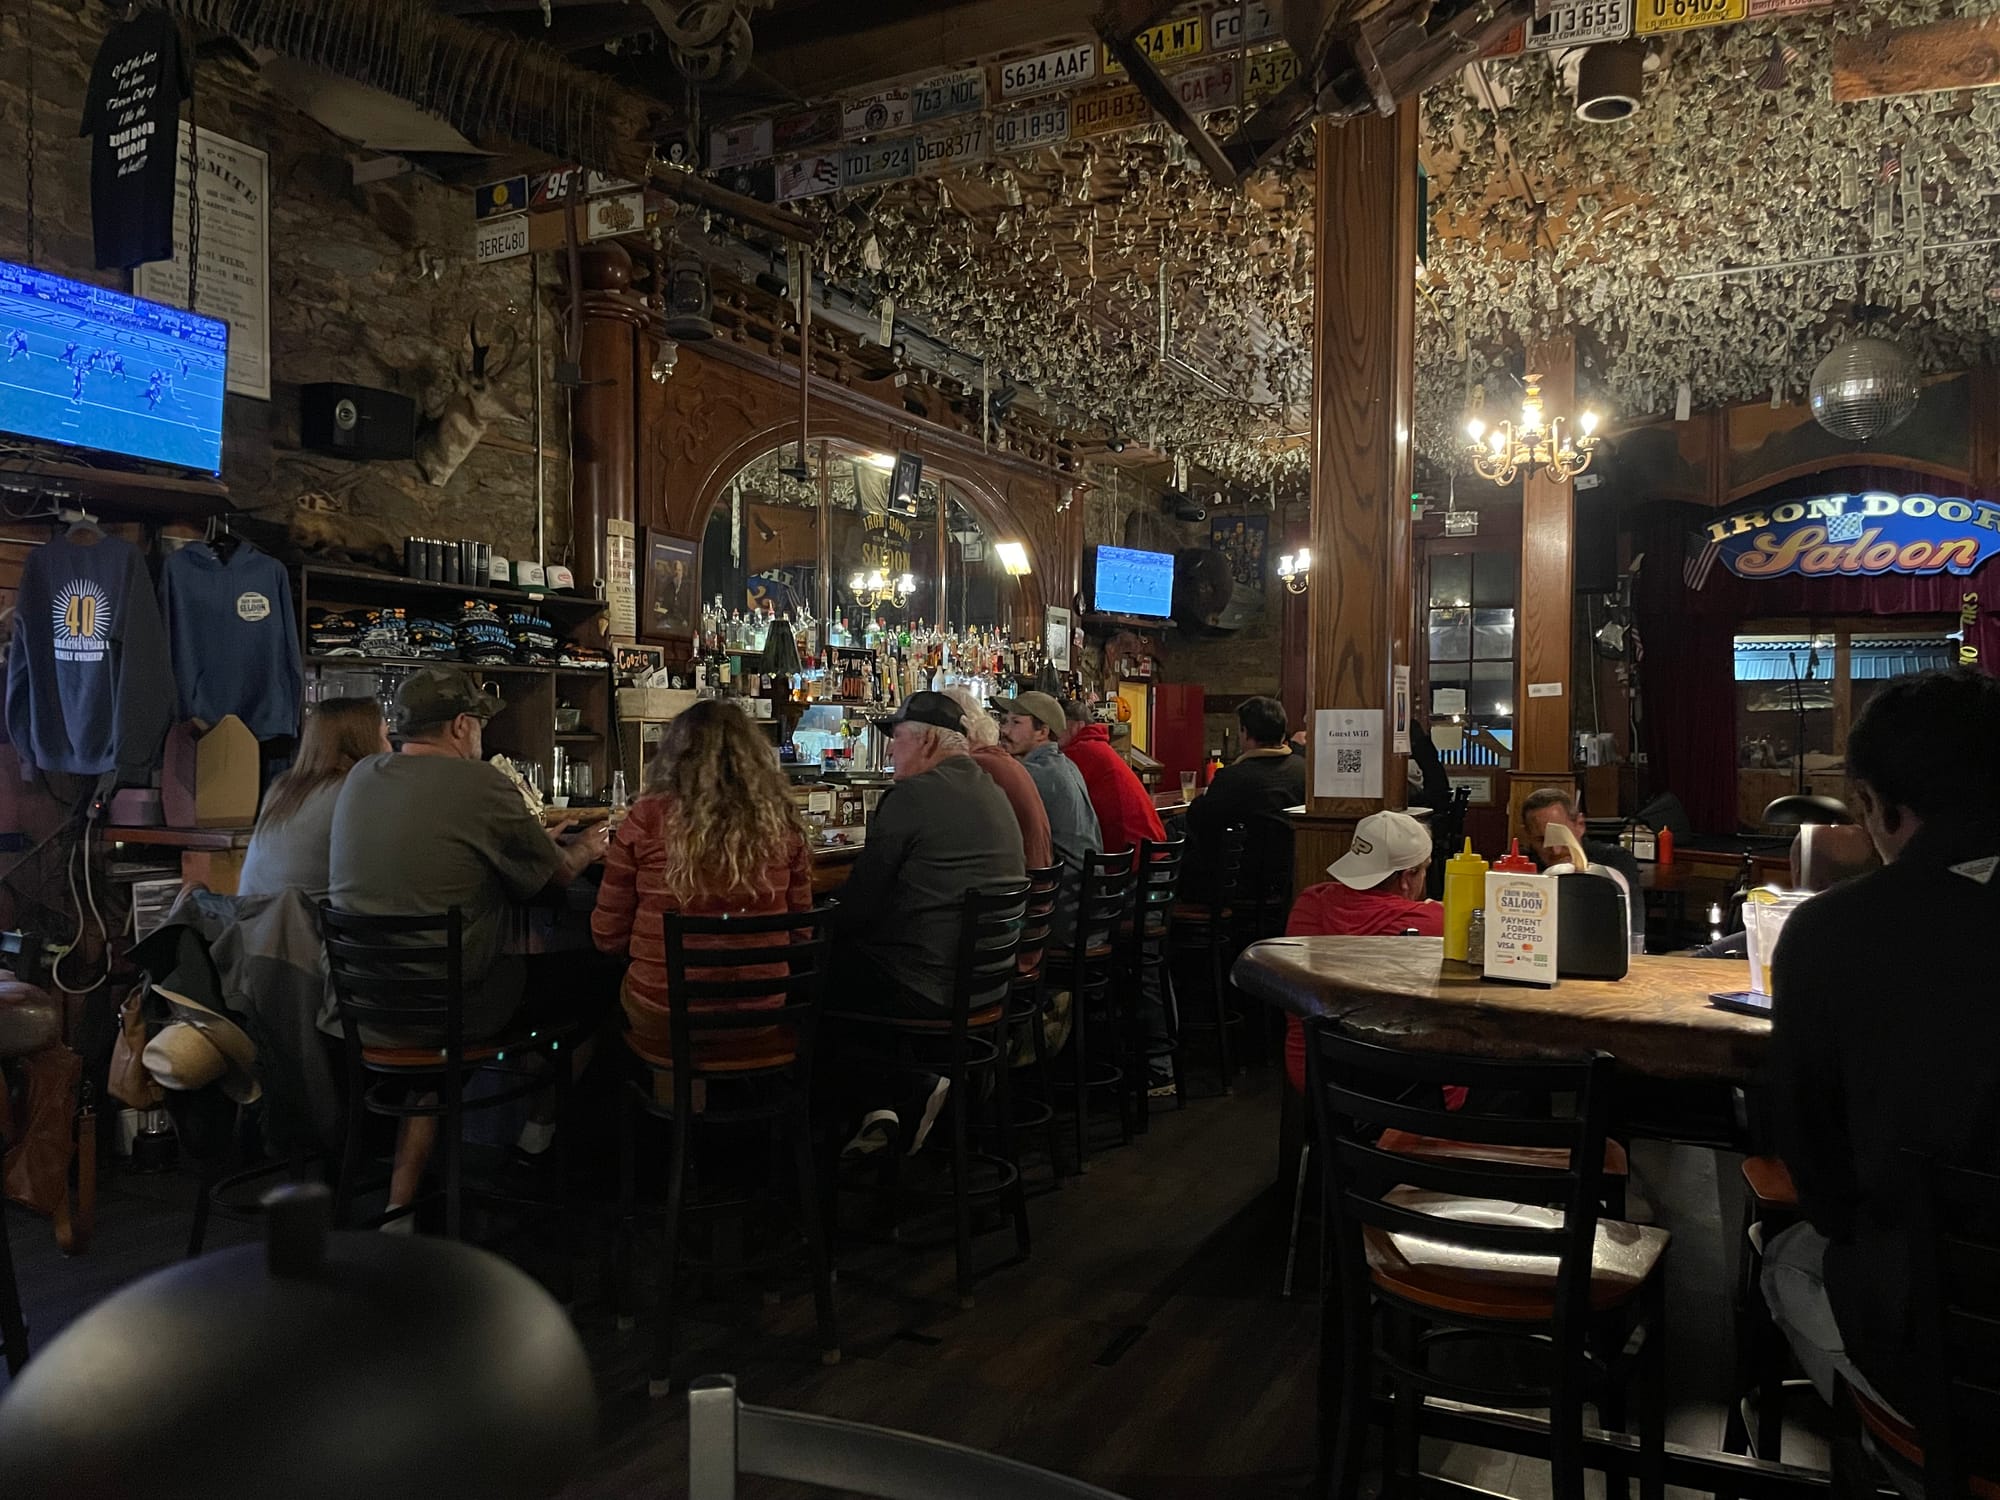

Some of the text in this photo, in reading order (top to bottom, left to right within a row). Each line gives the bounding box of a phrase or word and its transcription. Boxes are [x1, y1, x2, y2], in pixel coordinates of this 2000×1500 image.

[1689, 10, 1730, 23] PROVINCE
[1559, 29, 1591, 40] EDWARD
[1594, 24, 1623, 35] ISLAND
[929, 73, 964, 89] NEVADA
[917, 130, 981, 162] DED8377
[845, 147, 909, 176] TDI 924
[478, 231, 525, 258] 3ERE480
[1706, 491, 2000, 543] IRON DOOR
[862, 514, 885, 532] IRON
[888, 515, 911, 543] DOOR
[1735, 525, 1980, 574] Saloon
[64, 594, 96, 637] 40
[618, 650, 648, 670] Coozie
[1329, 730, 1351, 738] Guest
[1501, 897, 1543, 910] SALOON
[1500, 916, 1542, 927] PAYMENT
[1506, 925, 1536, 934] FORMS
[1496, 941, 1515, 949] VISA
[1501, 932, 1543, 943] ACCEPTED
